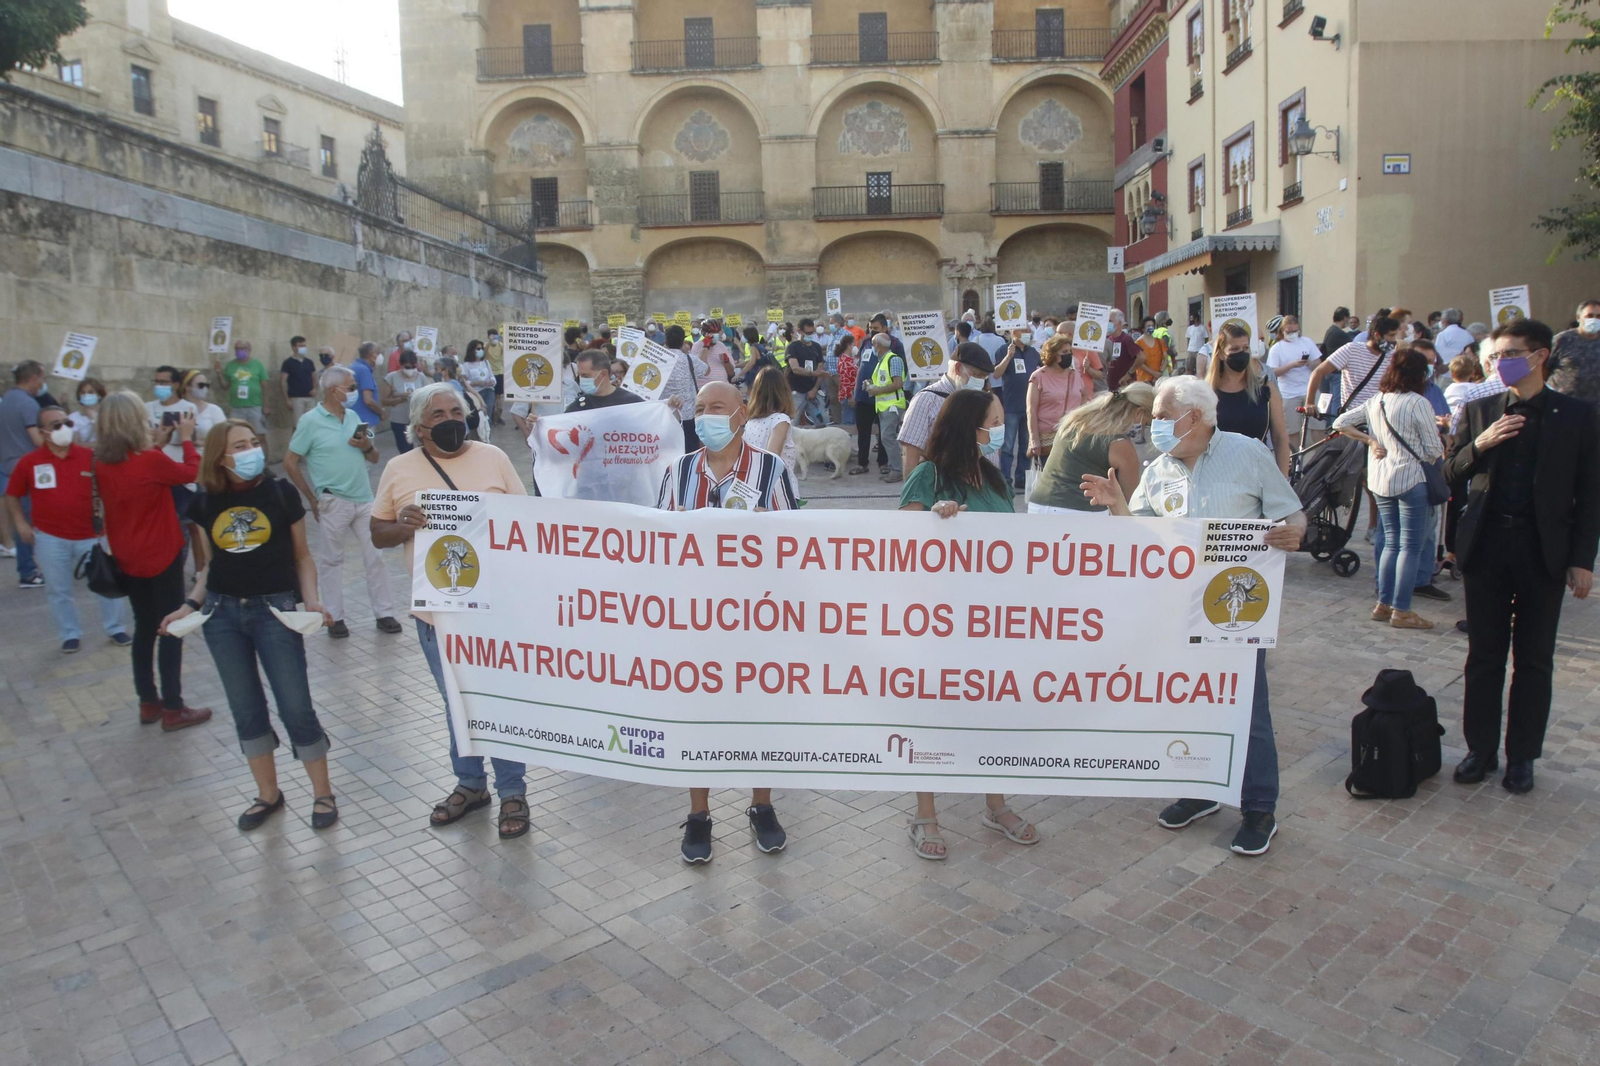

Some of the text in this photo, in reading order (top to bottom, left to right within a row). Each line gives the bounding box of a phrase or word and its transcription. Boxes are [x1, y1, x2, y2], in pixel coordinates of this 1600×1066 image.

[508, 325, 557, 333] RECUPEREMOS
[603, 430, 660, 443] CÓRDOBA
[421, 494, 480, 502] RECUPEREMOS
[421, 503, 458, 511] NUESTRO
[425, 513, 472, 521] ATRIMONIO
[1208, 523, 1277, 531] RECUPEREM
[1206, 533, 1254, 541] NUESTRO
[489, 519, 1195, 580] LA MEZQUITA ES PATRIMONIO PÚBLICO
[1205, 544, 1269, 552] PATRIMONIO
[1203, 553, 1248, 562] PÚBLICO
[558, 588, 1104, 642] ¡¡DEVOLUCIÓN DE LOS BIENES
[446, 633, 1238, 705] INMATRICULADOS POR LA IGLESIA CATÓLICA!!
[499, 724, 574, 745] LAICA-CÓRDOBA
[576, 736, 605, 750] LAICA
[620, 725, 665, 742] europa
[628, 740, 665, 758] laica
[681, 750, 882, 763] PLATAFORMA MEZQUITA-CATEDRAL
[978, 756, 1070, 768] COORDINADORA
[1073, 758, 1160, 770] RECUPERANDO
